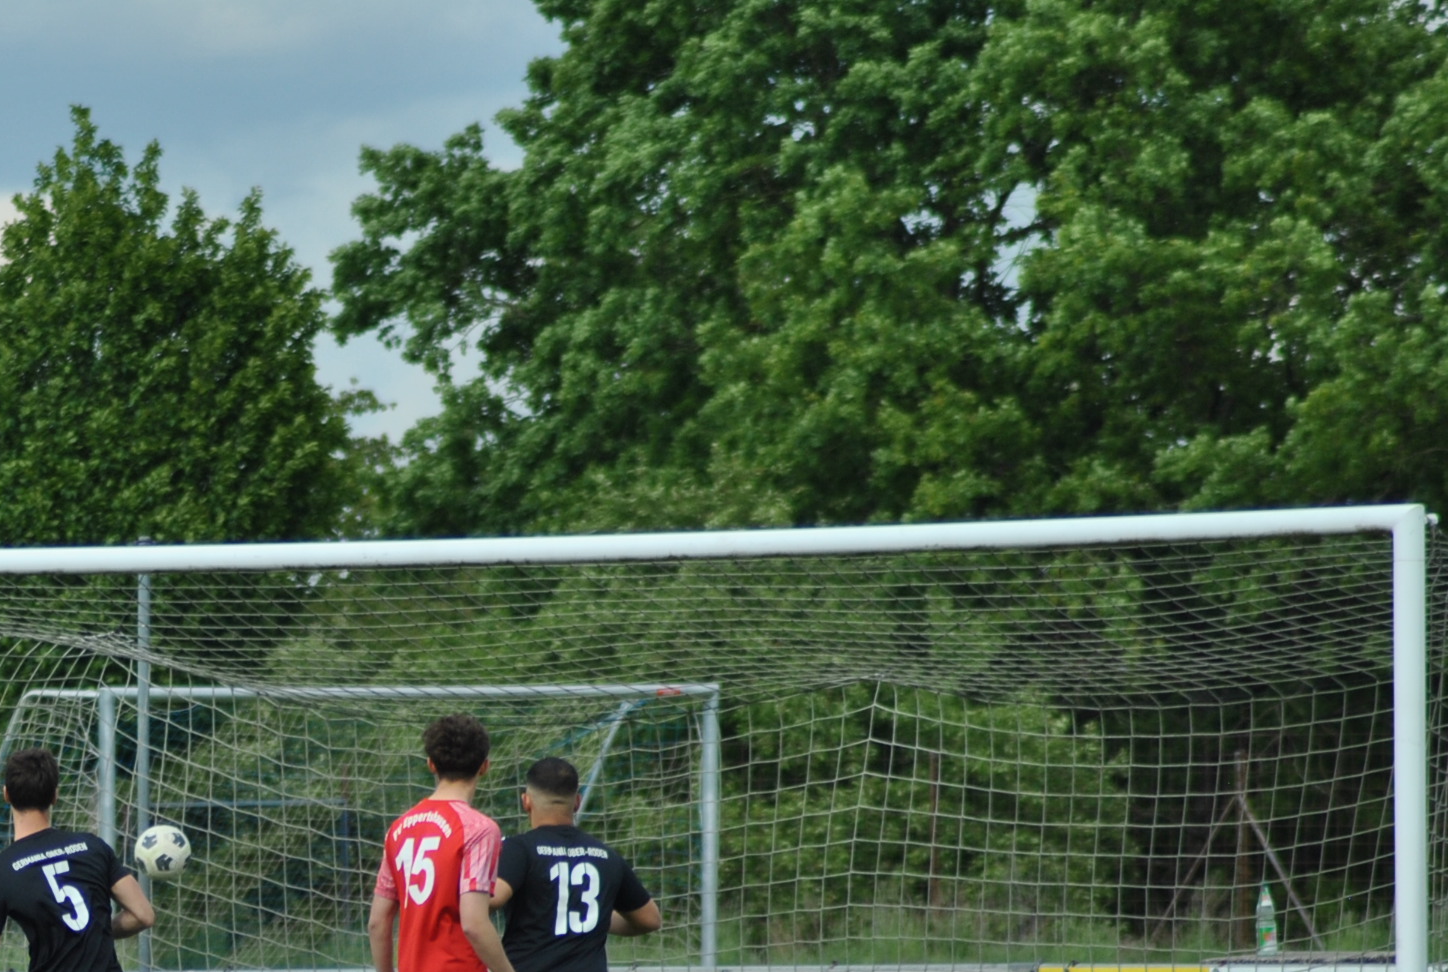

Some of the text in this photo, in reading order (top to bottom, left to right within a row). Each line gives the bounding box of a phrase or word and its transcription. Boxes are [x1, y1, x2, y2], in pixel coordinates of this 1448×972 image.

[41, 860, 89, 931] 5
[395, 836, 441, 909] 15
[549, 862, 600, 936] 13
